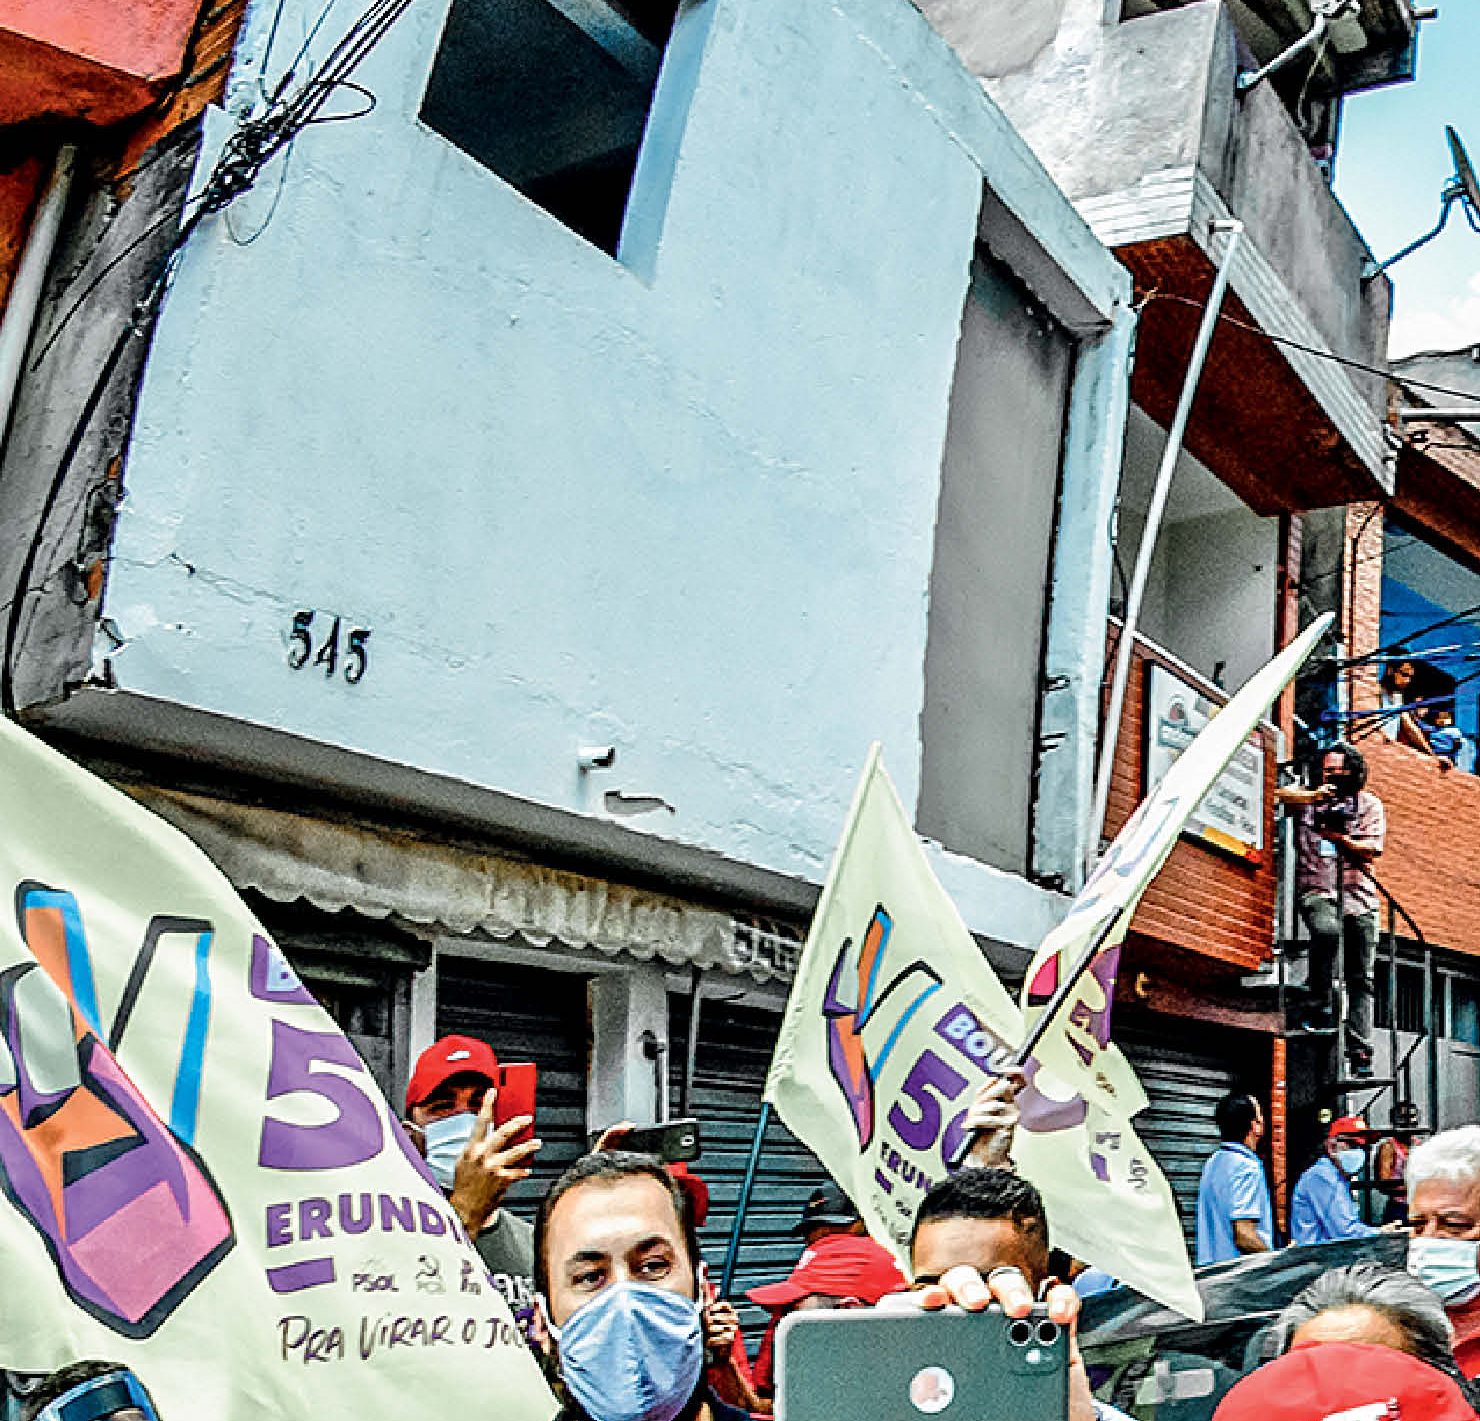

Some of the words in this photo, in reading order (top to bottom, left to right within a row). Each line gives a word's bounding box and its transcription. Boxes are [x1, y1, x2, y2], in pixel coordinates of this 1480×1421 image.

[287, 610, 372, 684] 545
[946, 1013, 1019, 1073] BOU
[258, 1017, 434, 1184] 5
[888, 1048, 970, 1173] 5
[278, 1314, 346, 1365] PRA
